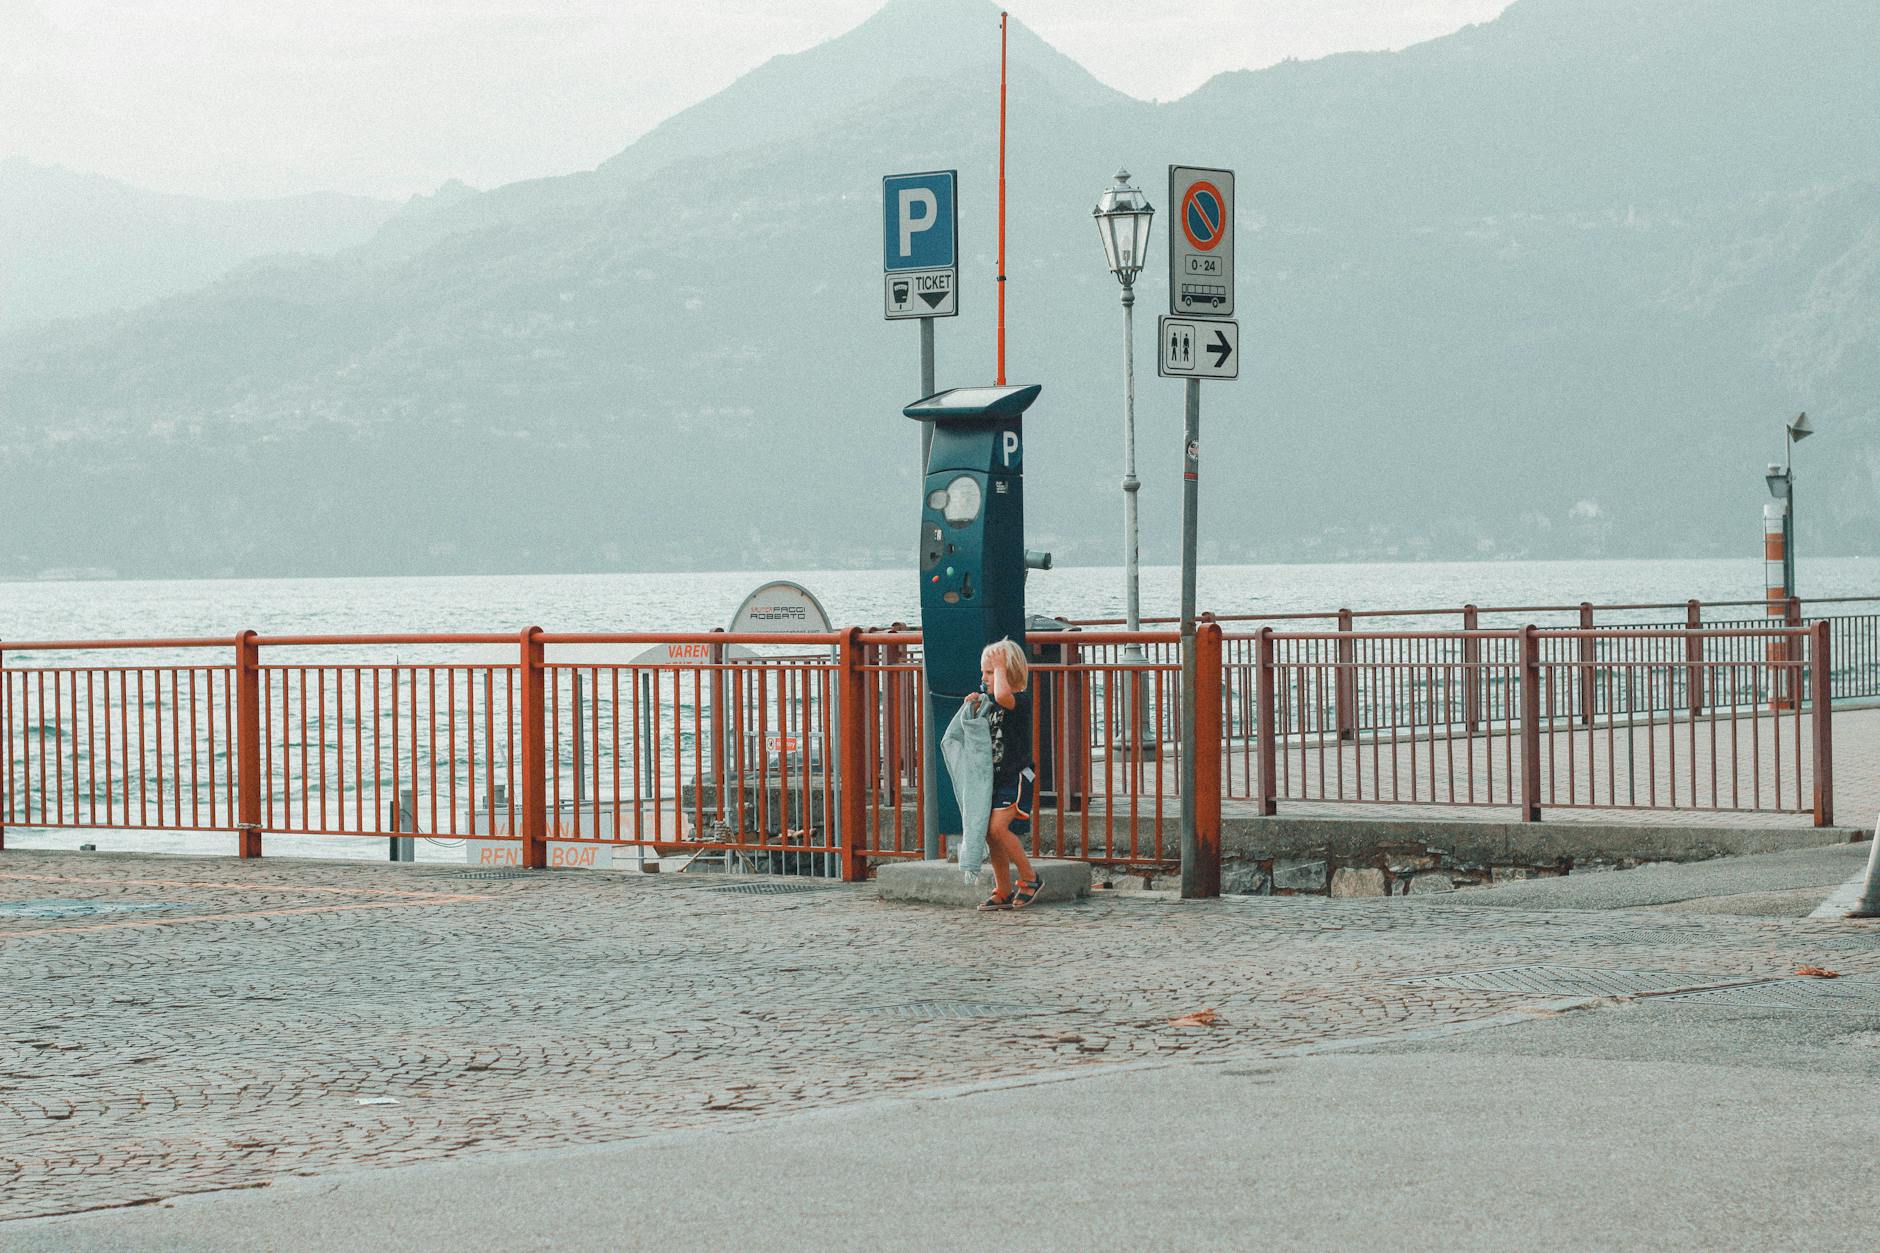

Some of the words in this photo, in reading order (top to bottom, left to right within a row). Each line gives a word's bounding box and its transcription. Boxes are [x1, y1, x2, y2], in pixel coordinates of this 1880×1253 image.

[899, 188, 937, 256] P
[916, 275, 951, 290] TICKET
[1003, 431, 1018, 466] P
[668, 645, 709, 658] VAREN
[480, 847, 523, 865] REN
[552, 846, 599, 867] BOAT
